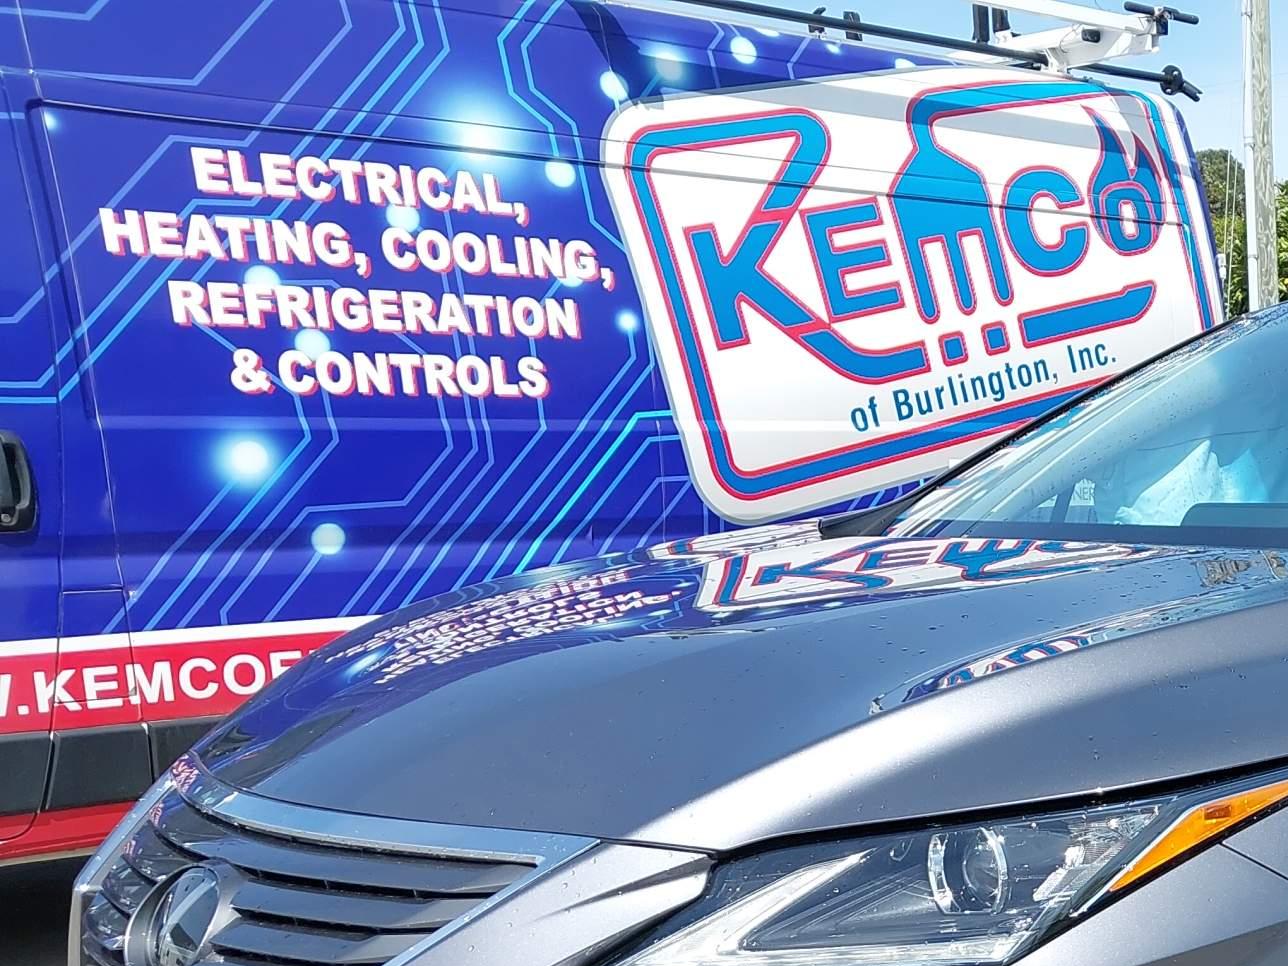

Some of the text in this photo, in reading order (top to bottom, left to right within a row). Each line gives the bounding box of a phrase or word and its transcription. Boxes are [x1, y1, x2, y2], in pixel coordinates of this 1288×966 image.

[189, 146, 530, 226] ELECTRICAL,
[98, 207, 616, 291] HEATING, COOLING,
[167, 279, 582, 340] REFRIGERATION
[229, 347, 549, 398] & CONTROLS
[850, 343, 1117, 432] of Burlington, Inc.
[0, 649, 321, 718] .KEMCOF
